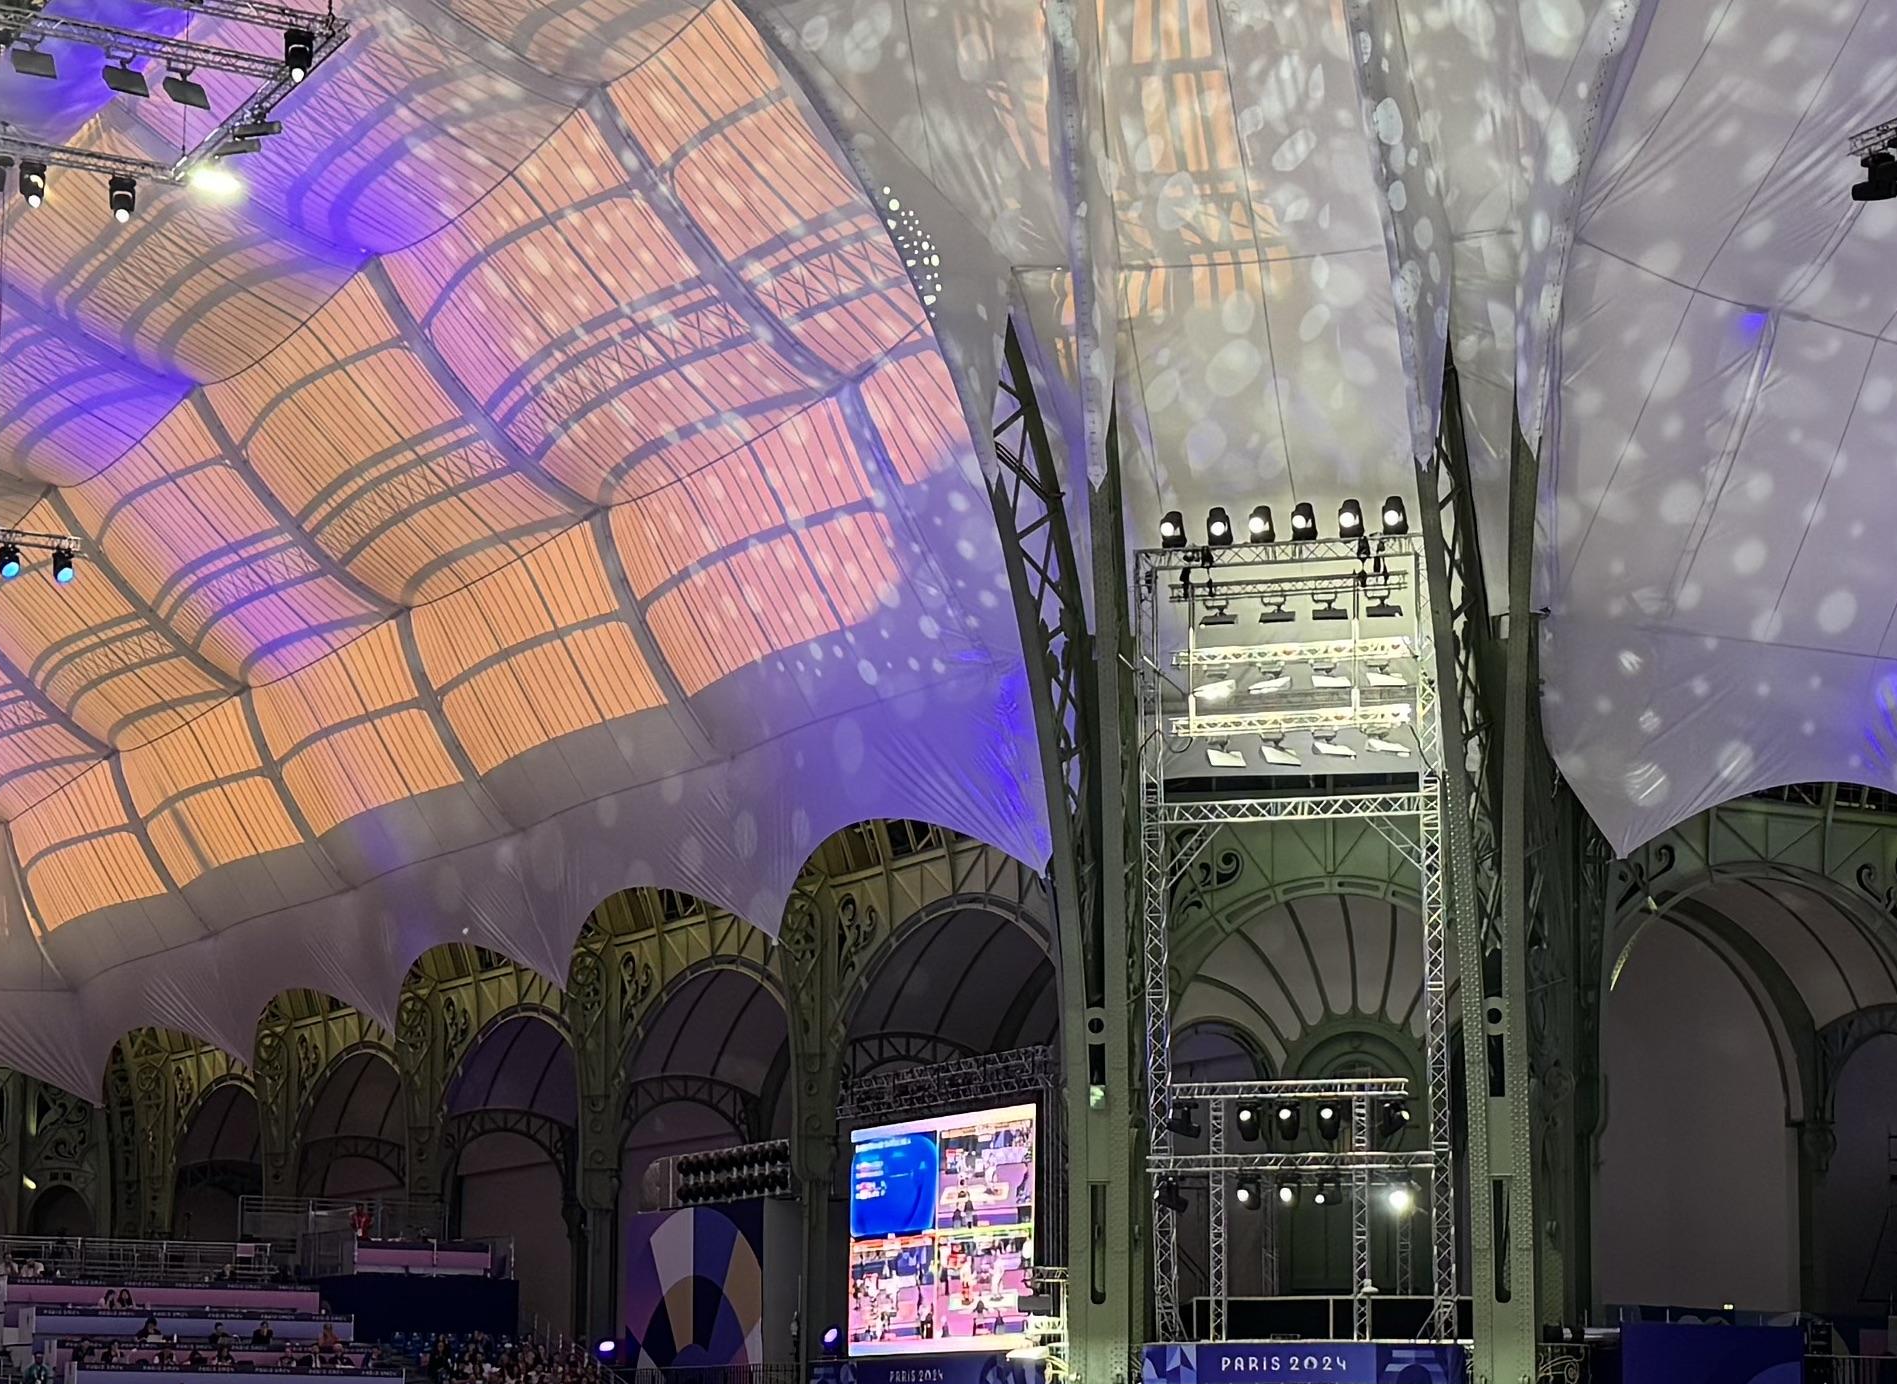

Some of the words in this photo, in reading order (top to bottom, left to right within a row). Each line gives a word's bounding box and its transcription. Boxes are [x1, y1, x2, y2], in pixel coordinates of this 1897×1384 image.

[1221, 1356, 1281, 1371] PARIS
[1290, 1355, 1346, 1371] 2024
[889, 1370, 916, 1383] PARIS
[918, 1369, 944, 1382] 2024
